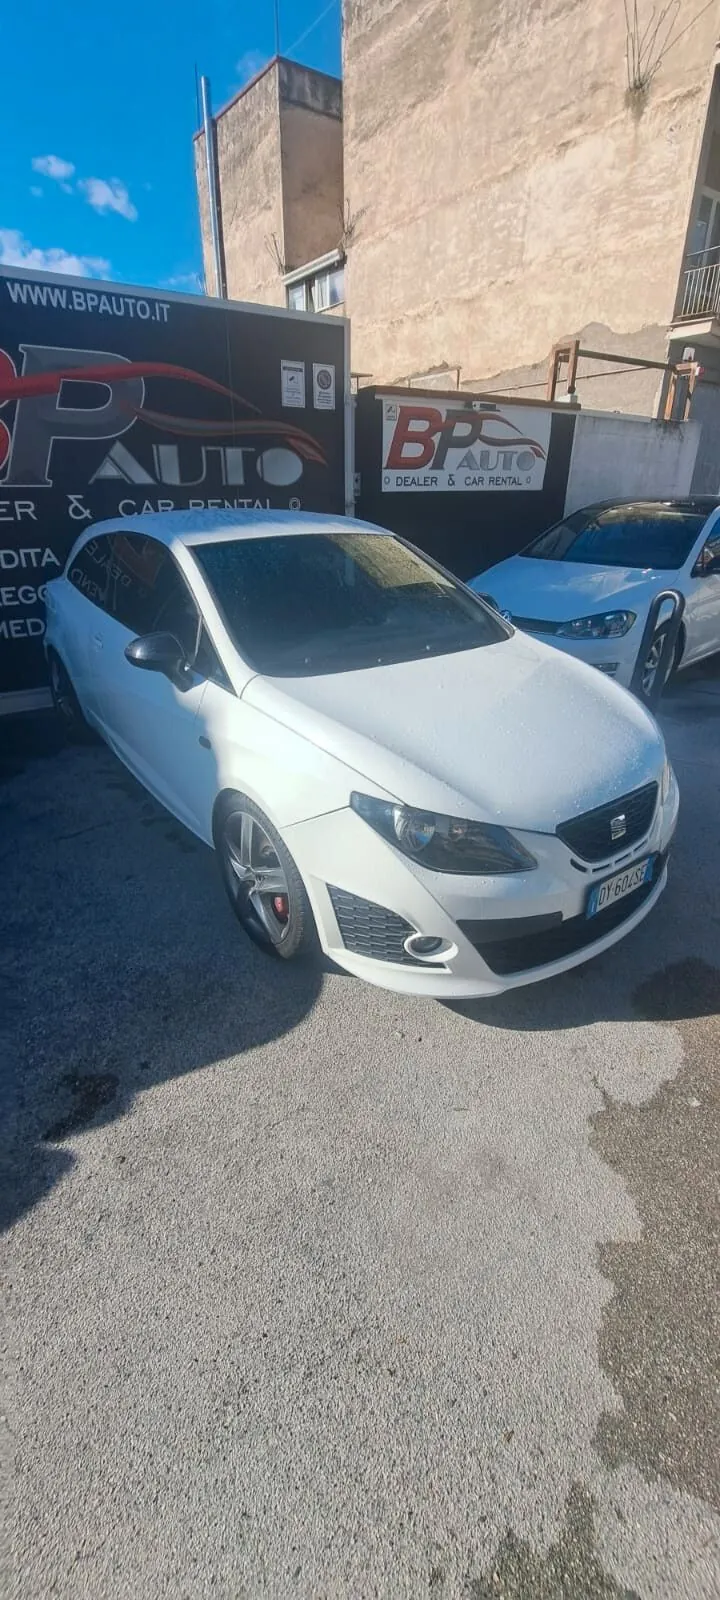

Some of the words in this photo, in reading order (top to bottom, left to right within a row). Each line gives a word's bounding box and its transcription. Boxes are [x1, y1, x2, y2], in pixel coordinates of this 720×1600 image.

[6, 281, 170, 323] WWW.BPAUTO.IT
[0, 344, 146, 487] P
[88, 440, 303, 486] AUTO
[383, 405, 484, 470] BP
[456, 449, 536, 471] AUTO
[395, 475, 438, 487] DEALER
[448, 474, 456, 486] &
[464, 476, 484, 486] CAR
[488, 476, 522, 486] RENTAL
[66, 494, 93, 520] &
[118, 499, 174, 517] CAR
